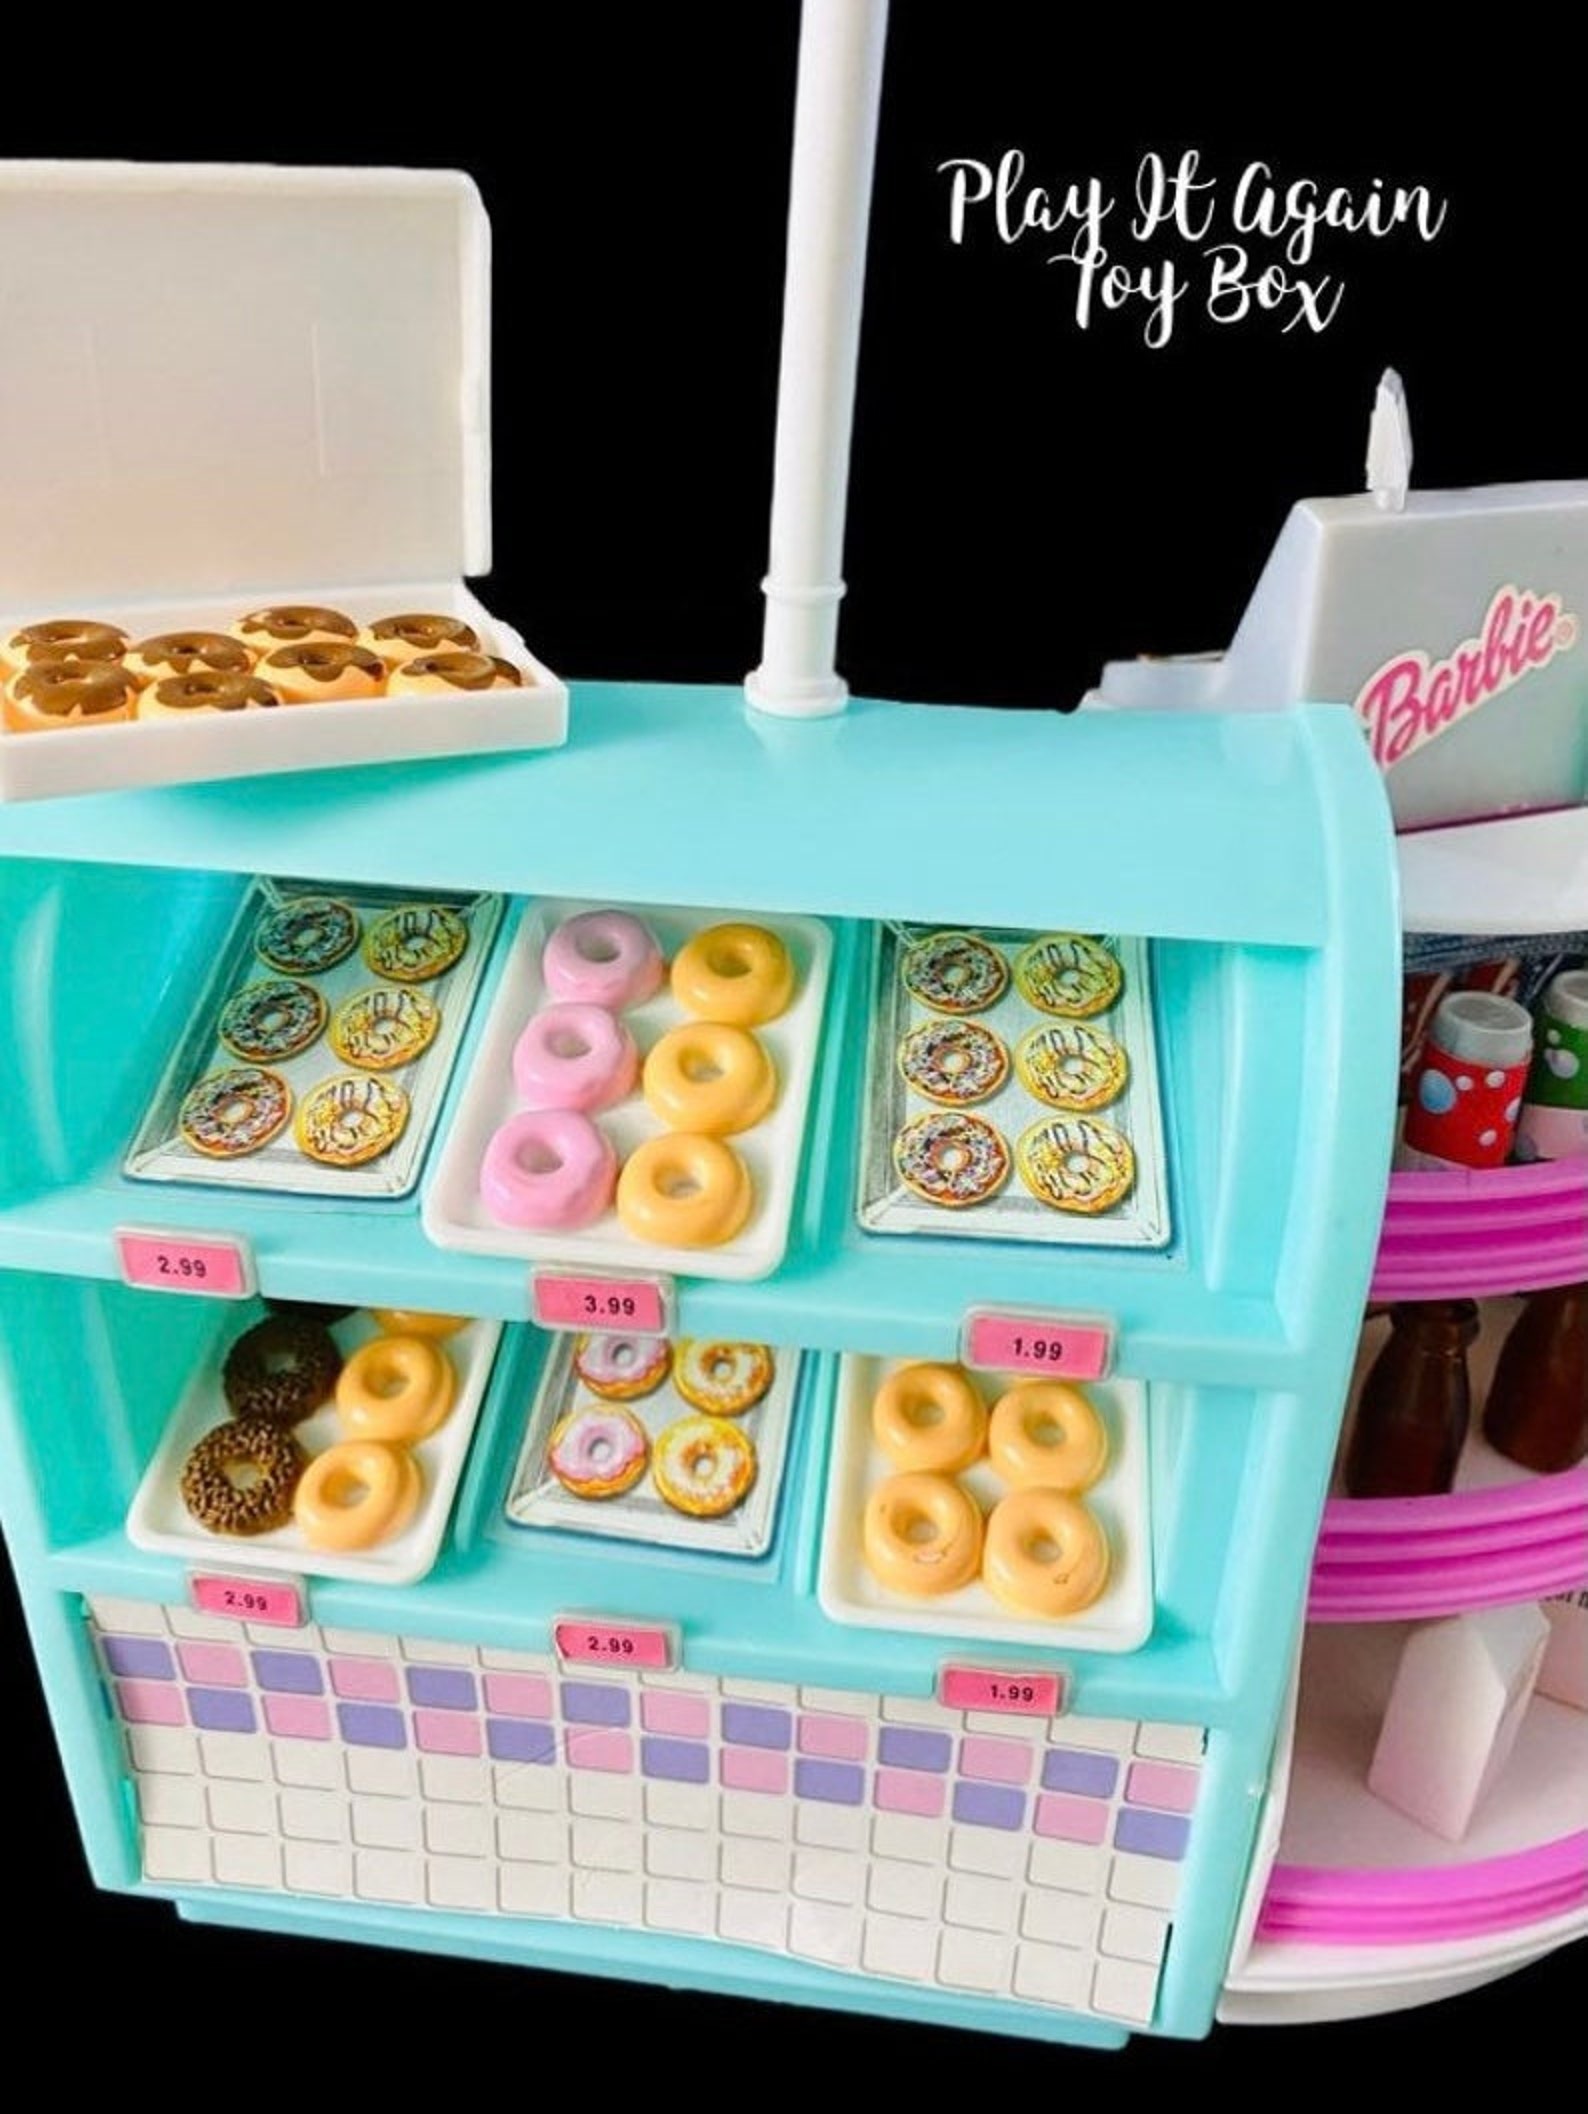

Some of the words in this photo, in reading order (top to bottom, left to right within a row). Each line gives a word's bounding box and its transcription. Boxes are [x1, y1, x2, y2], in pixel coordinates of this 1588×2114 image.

[1361, 595, 1556, 765] Barbie
[156, 1254, 208, 1279] 2.99
[583, 1294, 636, 1317] 3.99
[1012, 1336, 1064, 1362] 1.99
[223, 1590, 268, 1612] 2.99
[587, 1635, 635, 1655] 2.99
[989, 1683, 1035, 1703] 1.99
